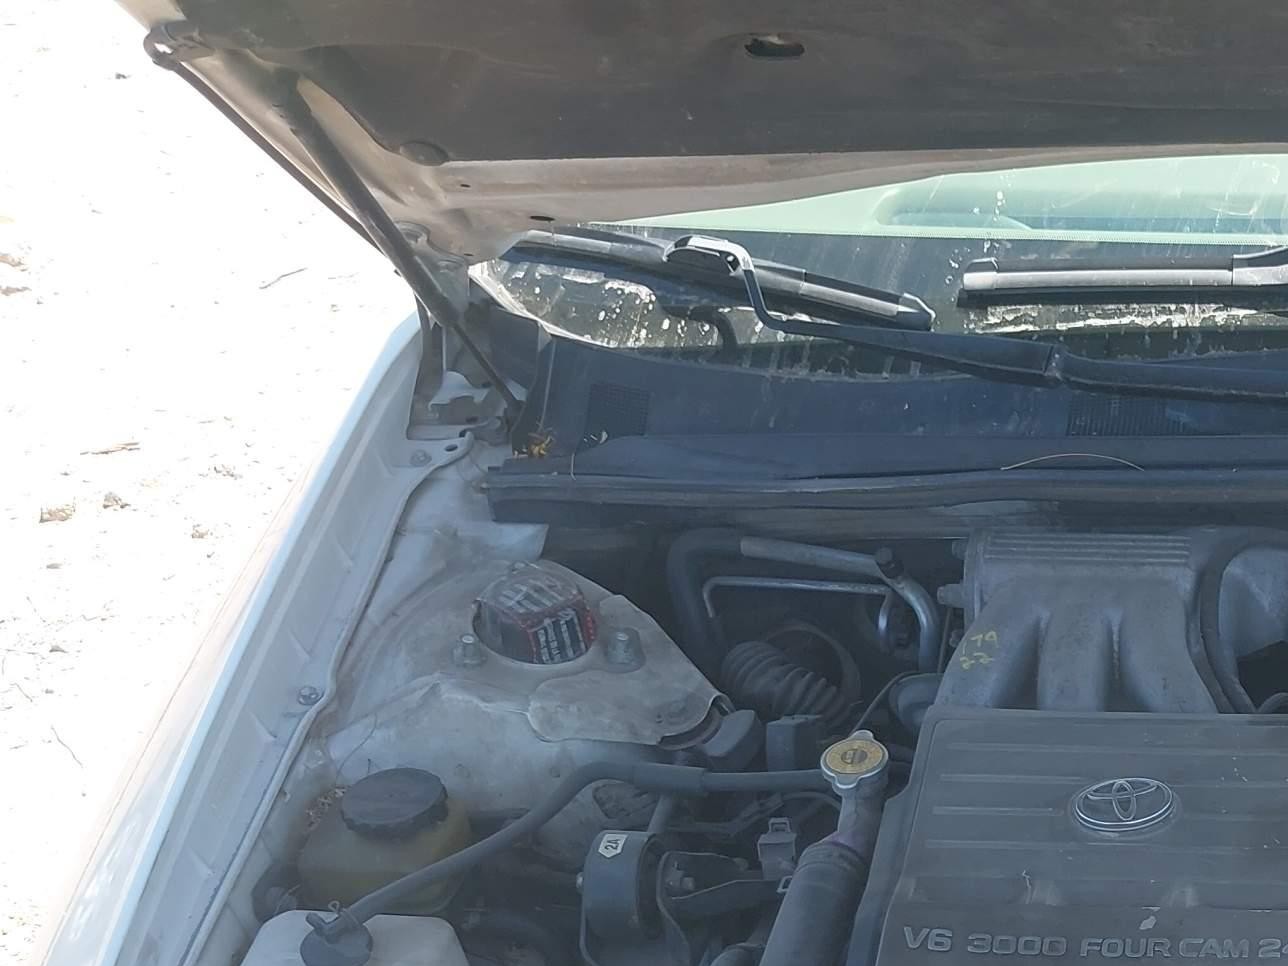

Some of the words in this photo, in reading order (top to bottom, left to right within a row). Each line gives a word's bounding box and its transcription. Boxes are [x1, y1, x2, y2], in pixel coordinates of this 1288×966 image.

[903, 926, 953, 952] V6
[966, 932, 1067, 957] 3000
[1079, 936, 1173, 958] FOUR
[1178, 937, 1249, 959] CAM
